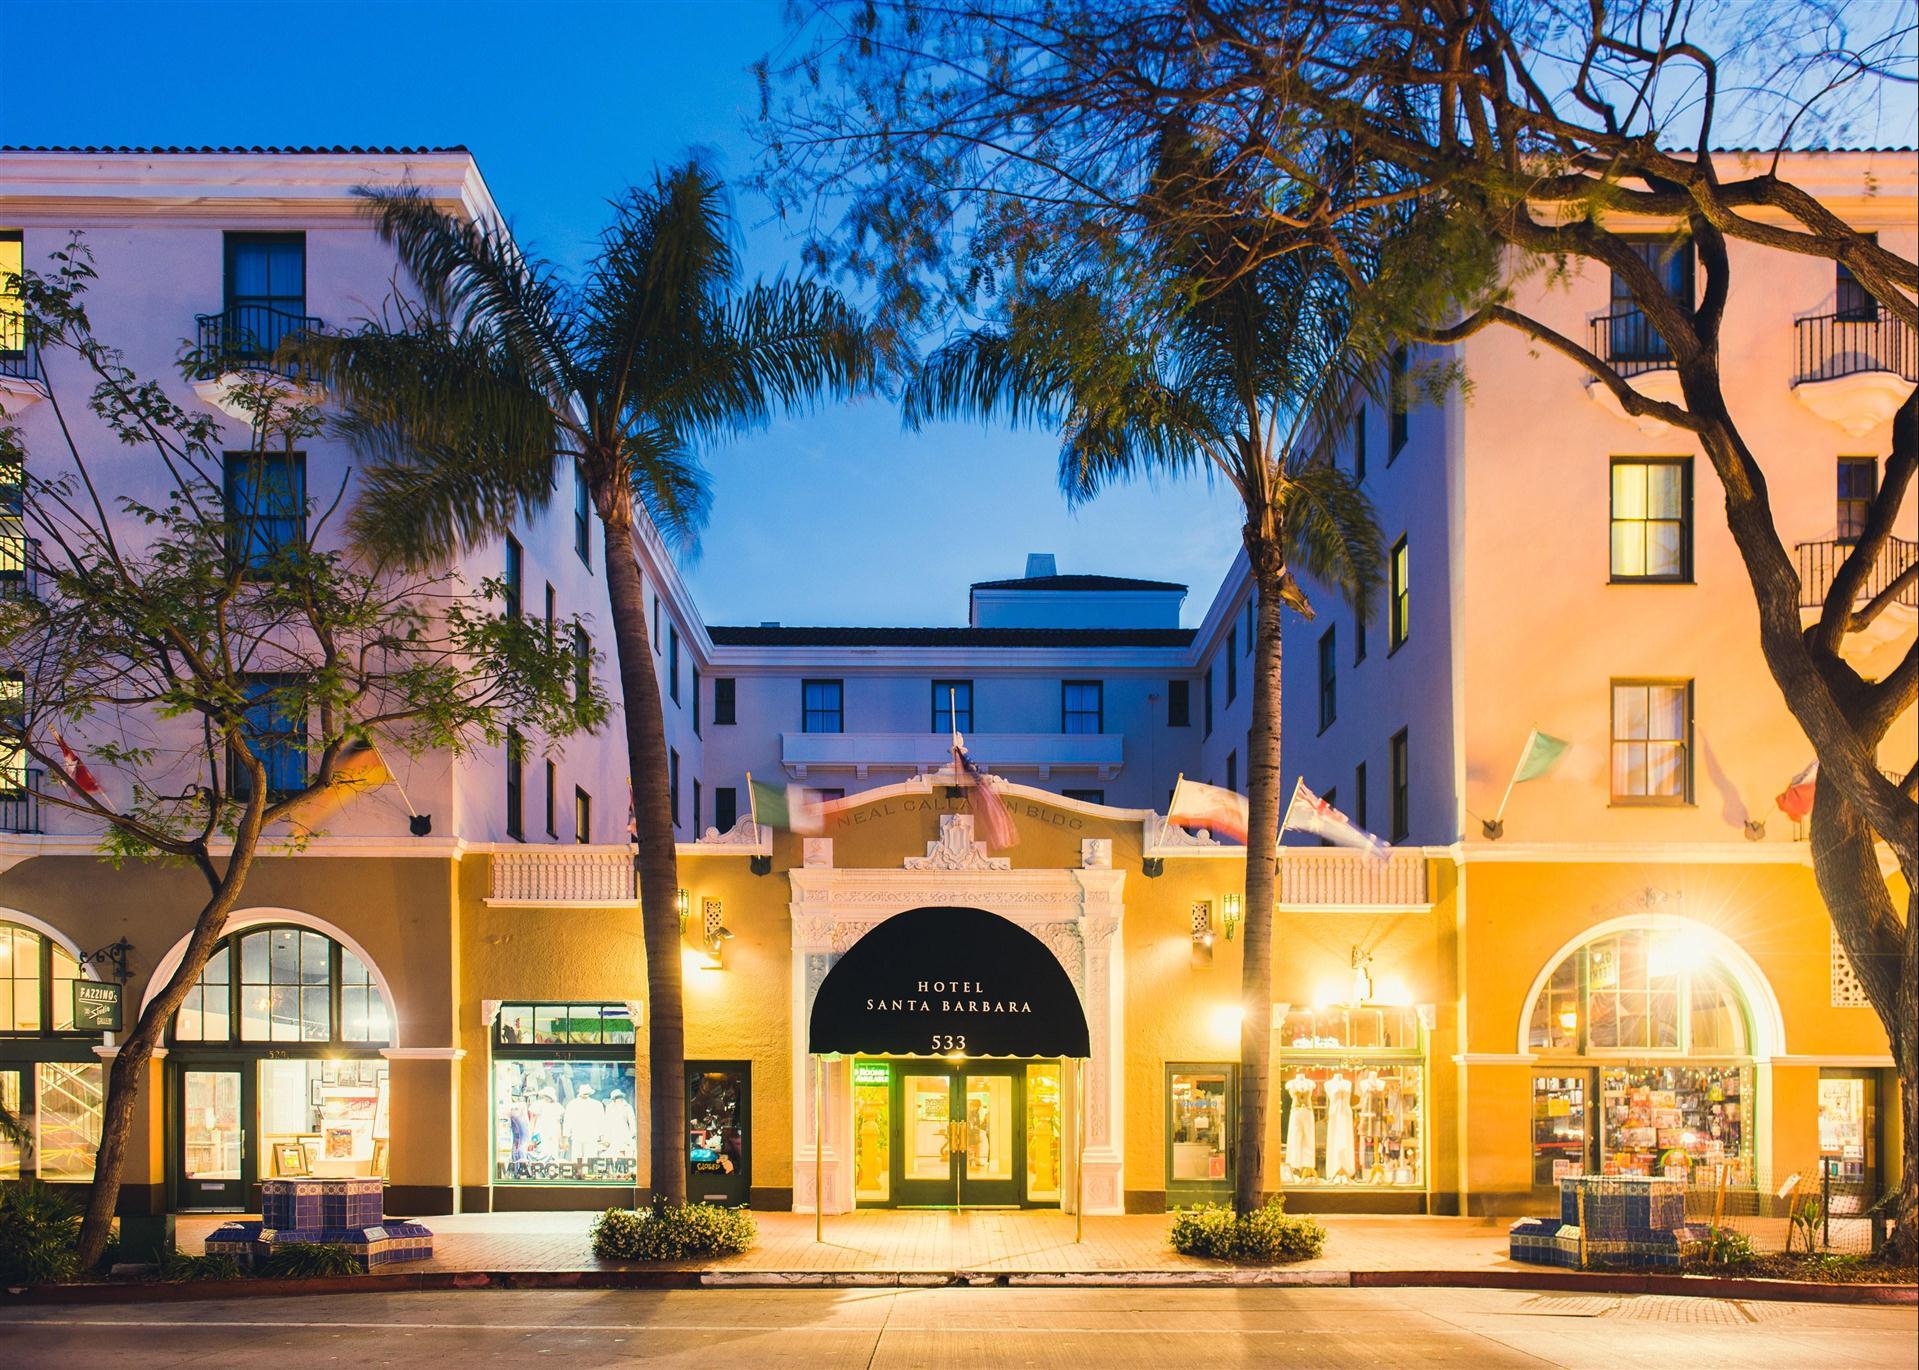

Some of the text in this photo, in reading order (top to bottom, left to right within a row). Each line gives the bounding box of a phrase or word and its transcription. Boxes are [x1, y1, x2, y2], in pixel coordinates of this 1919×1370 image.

[837, 797, 1083, 830] NEAL CALLAN BLDG
[918, 981, 984, 993] HOTEL
[866, 999, 1032, 1013] SANTA BARBARA
[931, 1035, 966, 1050] 533
